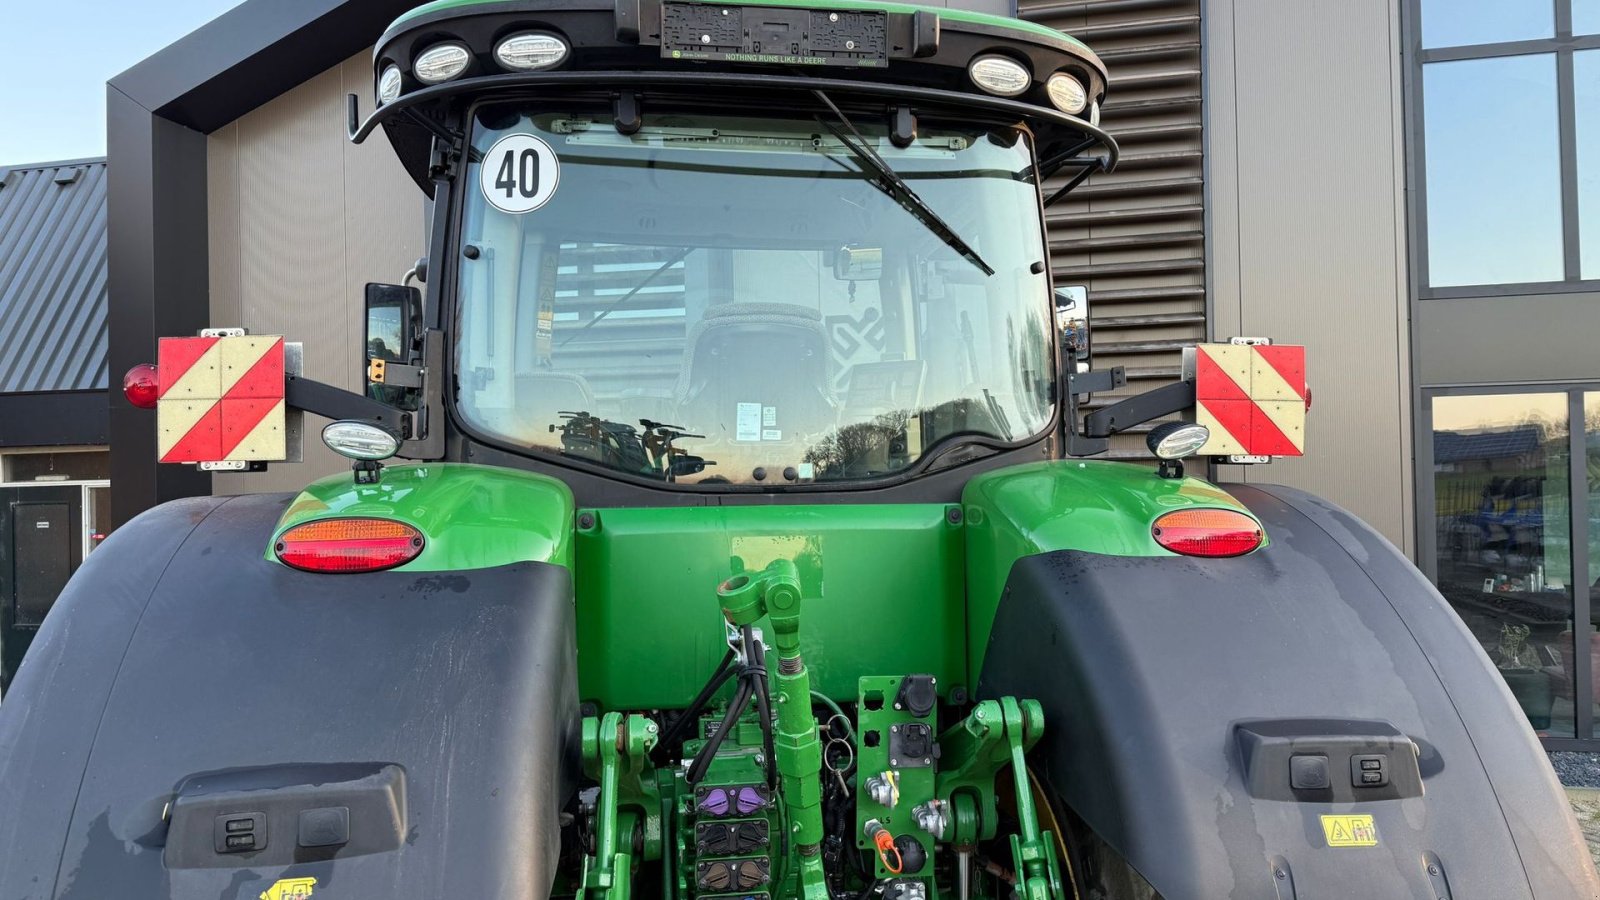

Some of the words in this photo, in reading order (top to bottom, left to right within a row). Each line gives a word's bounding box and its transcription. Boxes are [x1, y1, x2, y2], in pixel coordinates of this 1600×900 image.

[725, 53, 757, 62] NOTHING
[758, 54, 779, 62] RUNS
[780, 55, 796, 63] LIKE
[803, 56, 827, 65] DEERE
[495, 148, 540, 198] 40
